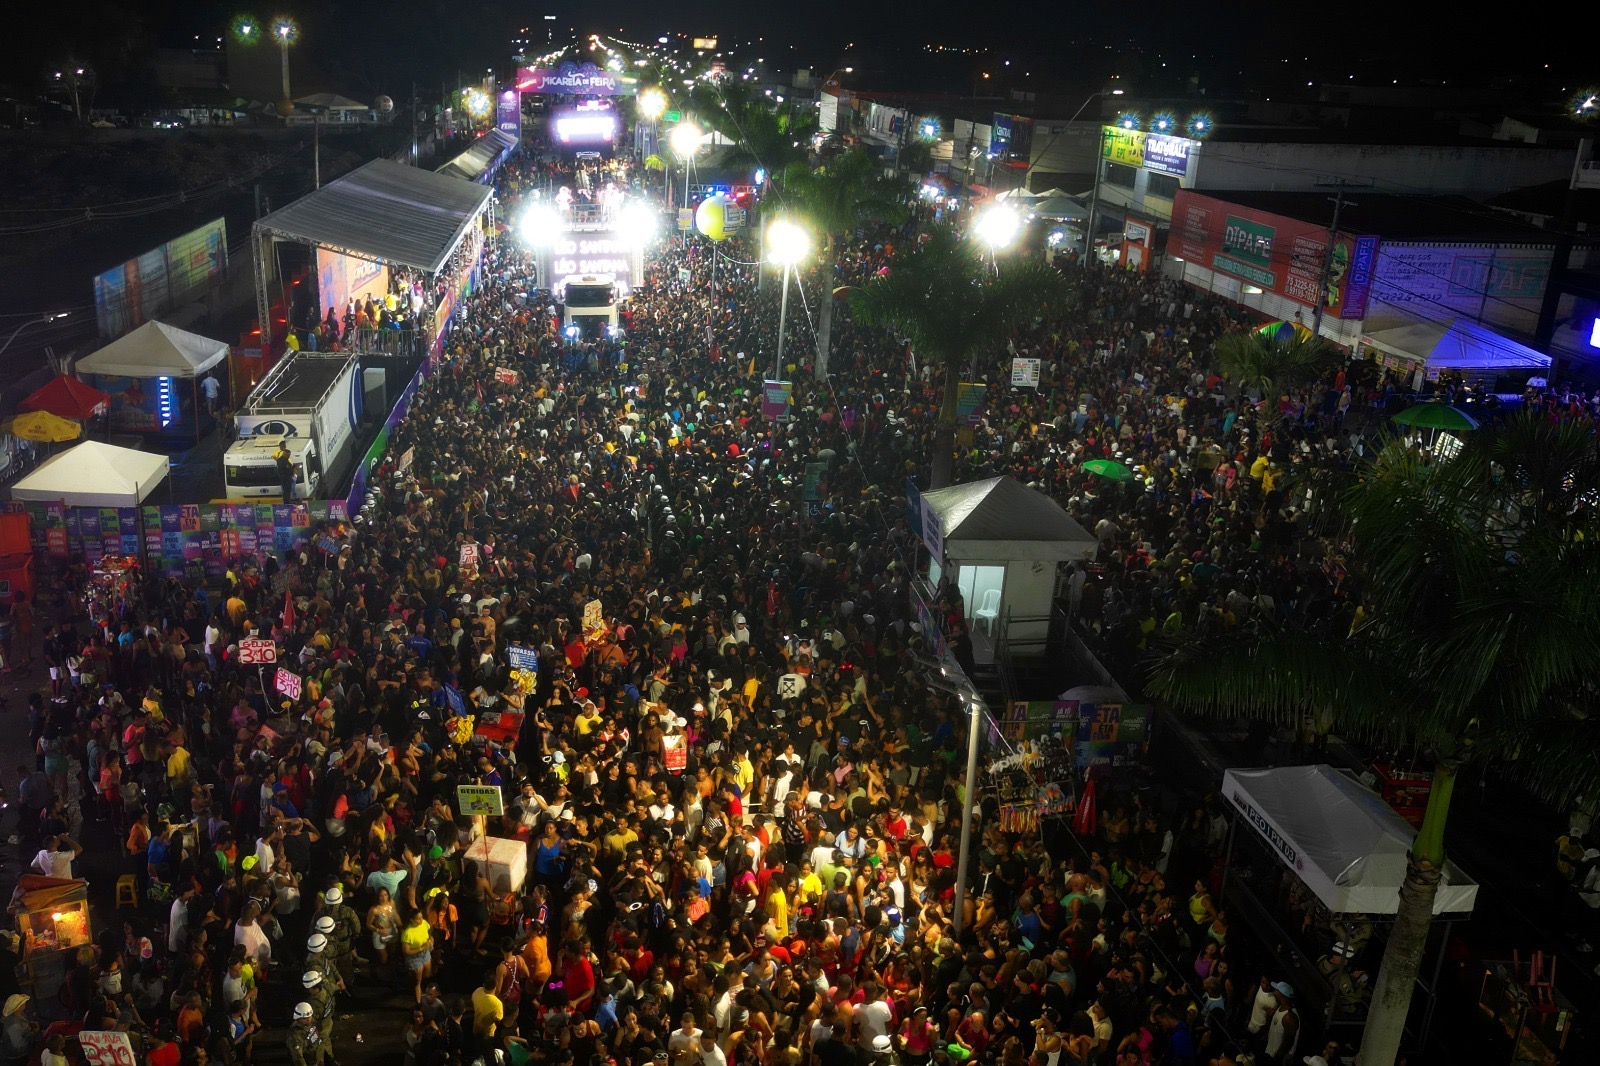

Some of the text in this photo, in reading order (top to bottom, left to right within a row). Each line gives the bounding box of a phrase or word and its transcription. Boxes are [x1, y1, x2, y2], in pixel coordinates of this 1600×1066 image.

[537, 72, 582, 88] MICARETA
[590, 76, 615, 90] FEIRA
[1224, 225, 1272, 258] DIPAFE
[554, 257, 629, 274] LÉO SANTANA
[1354, 240, 1371, 281] DIPAFE
[1294, 278, 1319, 294] 3225-521
[182, 506, 199, 518] ETA
[242, 640, 275, 648] GELADA
[509, 646, 535, 657] DEVASSA
[1094, 707, 1121, 723] ETA
[1249, 808, 1266, 831] PEO
[1271, 831, 1284, 851] PM
[1284, 844, 1294, 861] 03
